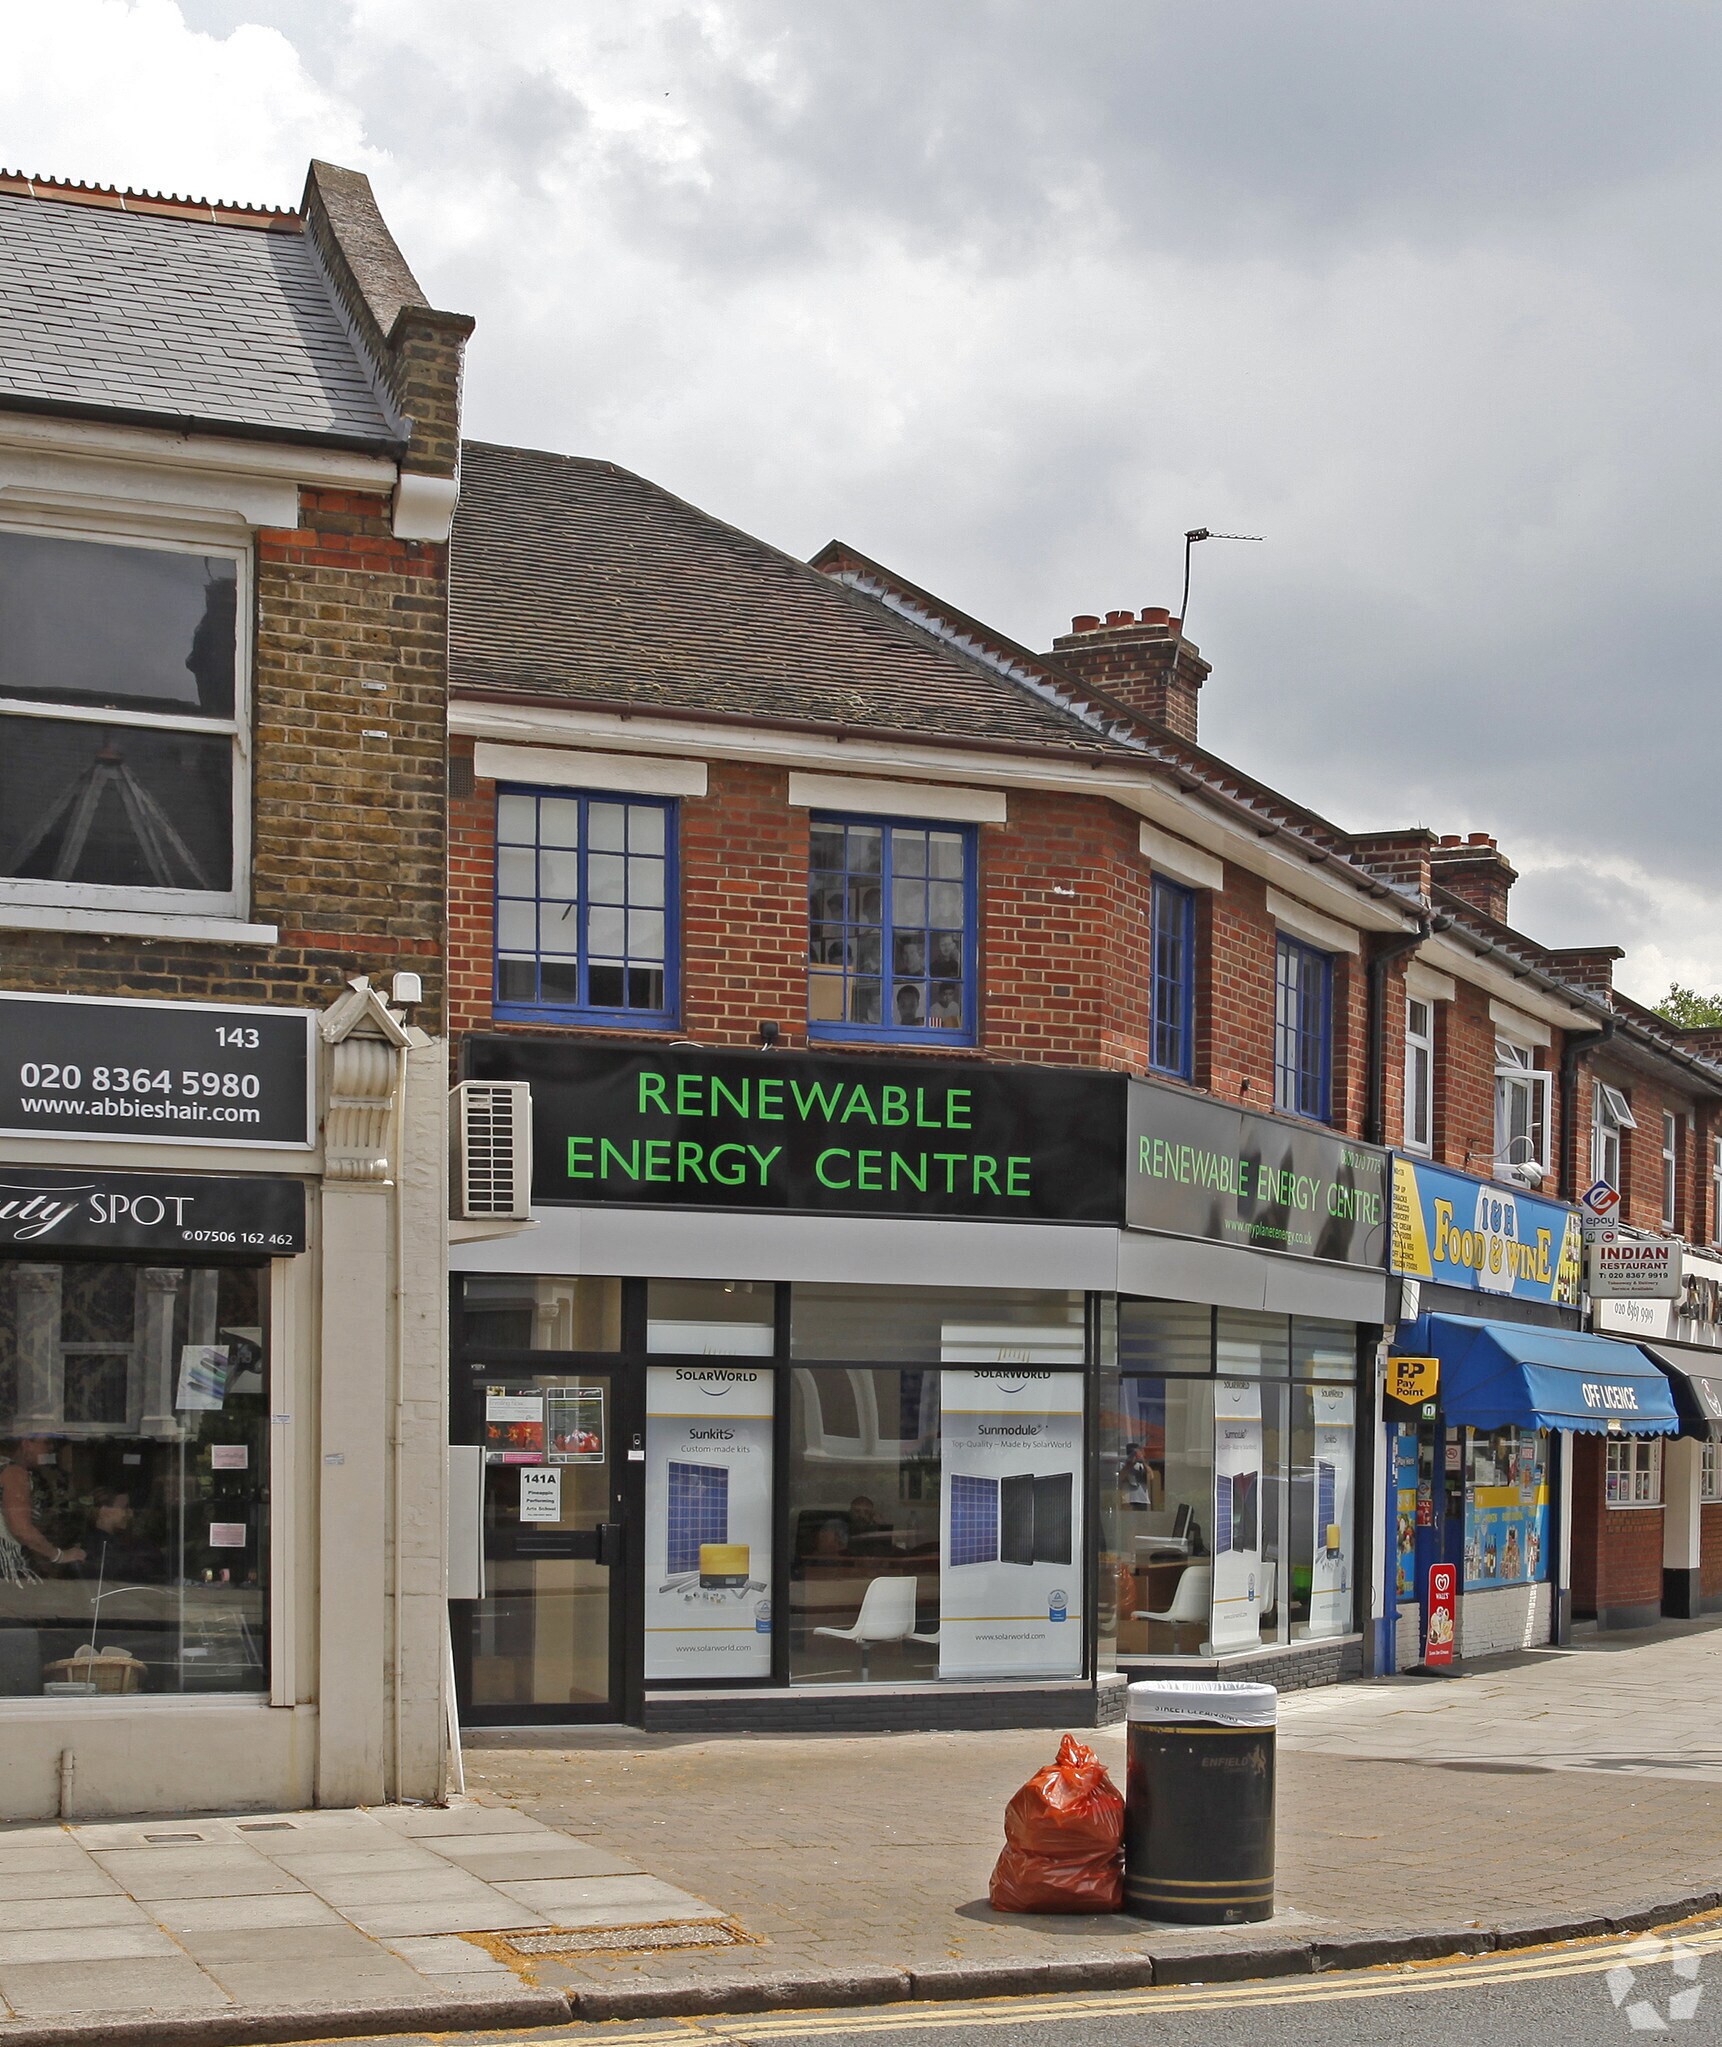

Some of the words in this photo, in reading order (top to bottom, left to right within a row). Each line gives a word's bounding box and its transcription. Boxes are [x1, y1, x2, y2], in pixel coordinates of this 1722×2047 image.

[215, 1026, 260, 1048] 143
[20, 1063, 82, 1089] 020
[92, 1066, 172, 1094] 8364
[182, 1071, 260, 1099] 5980
[638, 1072, 972, 1130] RENEWABLE
[20, 1098, 260, 1123] www.abbieshair.com
[566, 1136, 782, 1186] ENERGY
[815, 1148, 1032, 1197] CENTRE
[1138, 1135, 1248, 1197] RENEWABLE
[1256, 1164, 1320, 1212] ENERGY
[1327, 1182, 1380, 1226] CENTRE
[89, 1193, 194, 1226] SPOT
[1481, 1197, 1490, 1230] I
[1490, 1200, 1501, 1233] &
[1504, 1203, 1514, 1237] H
[1586, 1217, 1615, 1227] epay
[194, 1230, 236, 1243] 07506
[240, 1233, 264, 1244] 162
[268, 1234, 293, 1245] 462
[1489, 1235, 1503, 1274] &
[1505, 1226, 1552, 1284] WINE
[1600, 1247, 1669, 1260] INDIAN
[1600, 1262, 1668, 1270] RESTAURANT
[1614, 1302, 1626, 1315] 020
[1397, 1379, 1415, 1389] Pay
[1397, 1388, 1425, 1396] Point
[1582, 1383, 1601, 1408] OFF
[1600, 1385, 1639, 1410] LICENCE
[978, 1424, 1043, 1436] Sunmodule
[681, 1444, 735, 1453] Custom-made
[737, 1445, 750, 1453] kits
[952, 1440, 993, 1449] Top-Quality
[1001, 1440, 1020, 1448] Made
[1023, 1441, 1031, 1449] by
[1033, 1441, 1072, 1449] SolarWorld
[524, 1474, 556, 1483] 141A
[676, 1644, 752, 1653] www.solarworld.com
[1202, 1757, 1249, 1767] ENFIELD
